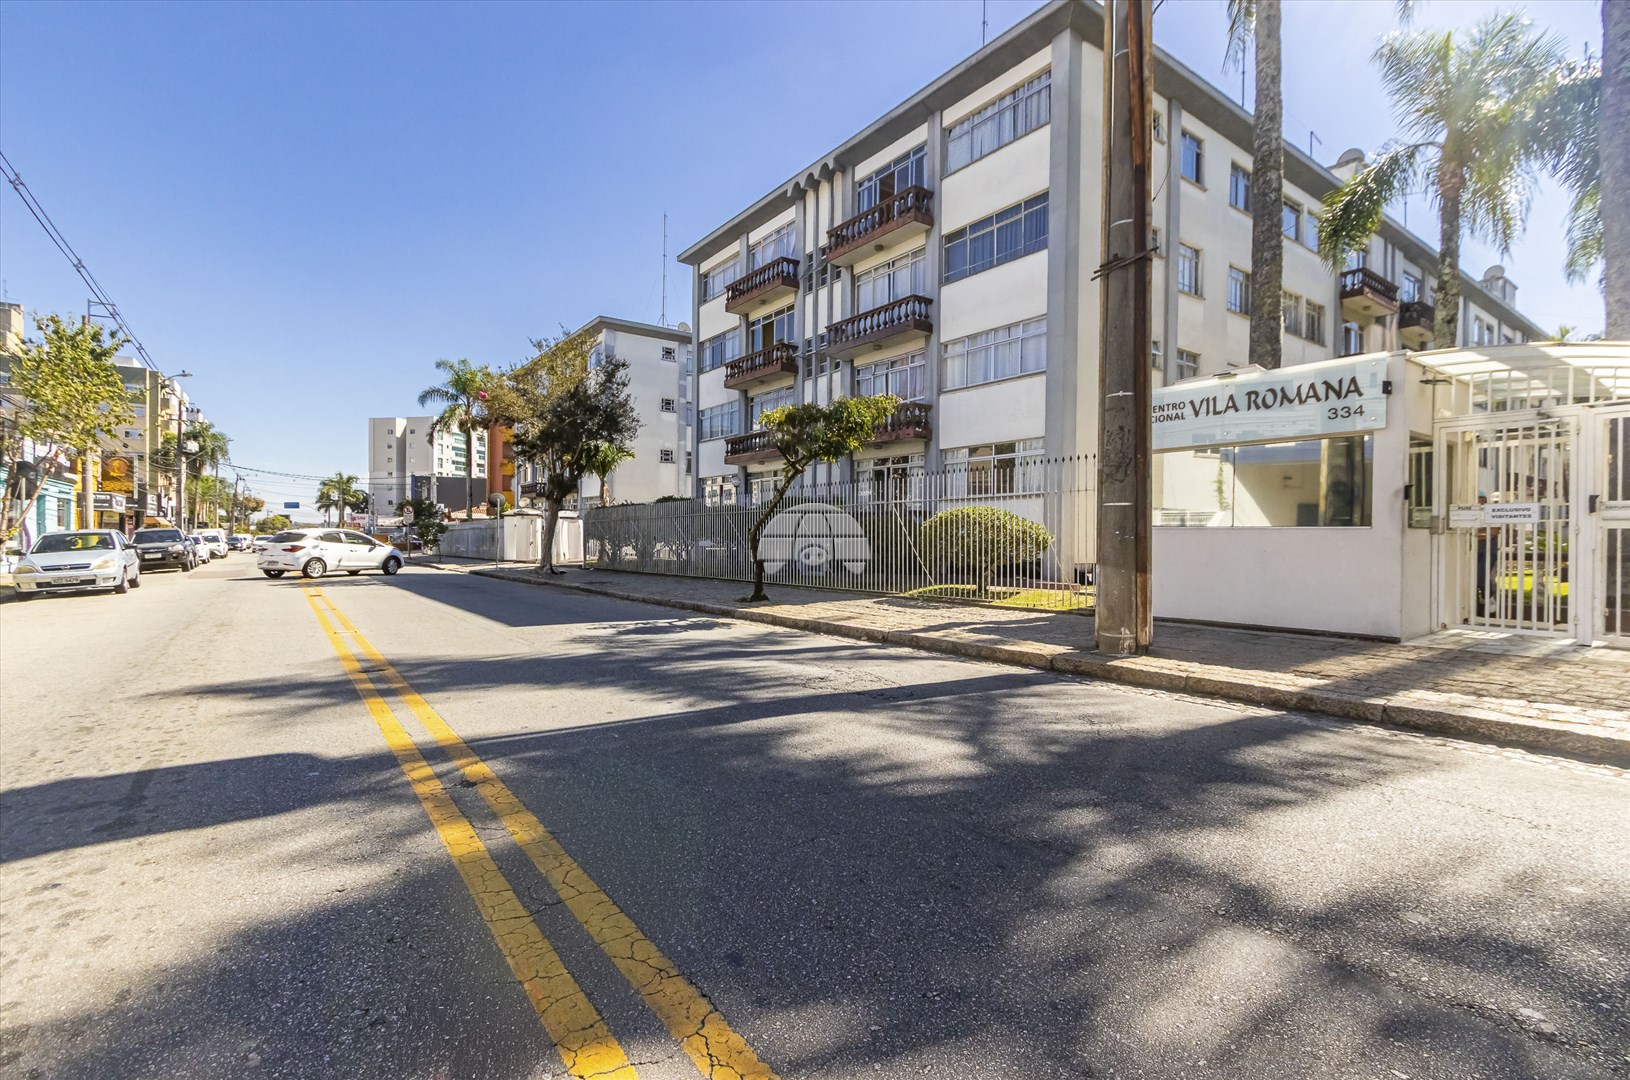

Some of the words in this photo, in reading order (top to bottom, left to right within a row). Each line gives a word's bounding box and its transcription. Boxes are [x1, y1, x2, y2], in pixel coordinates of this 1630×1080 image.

[1189, 393, 1240, 418] VILA
[1245, 375, 1365, 411] ROMANA
[1152, 401, 1186, 414] ENTRO
[1327, 405, 1366, 420] 334
